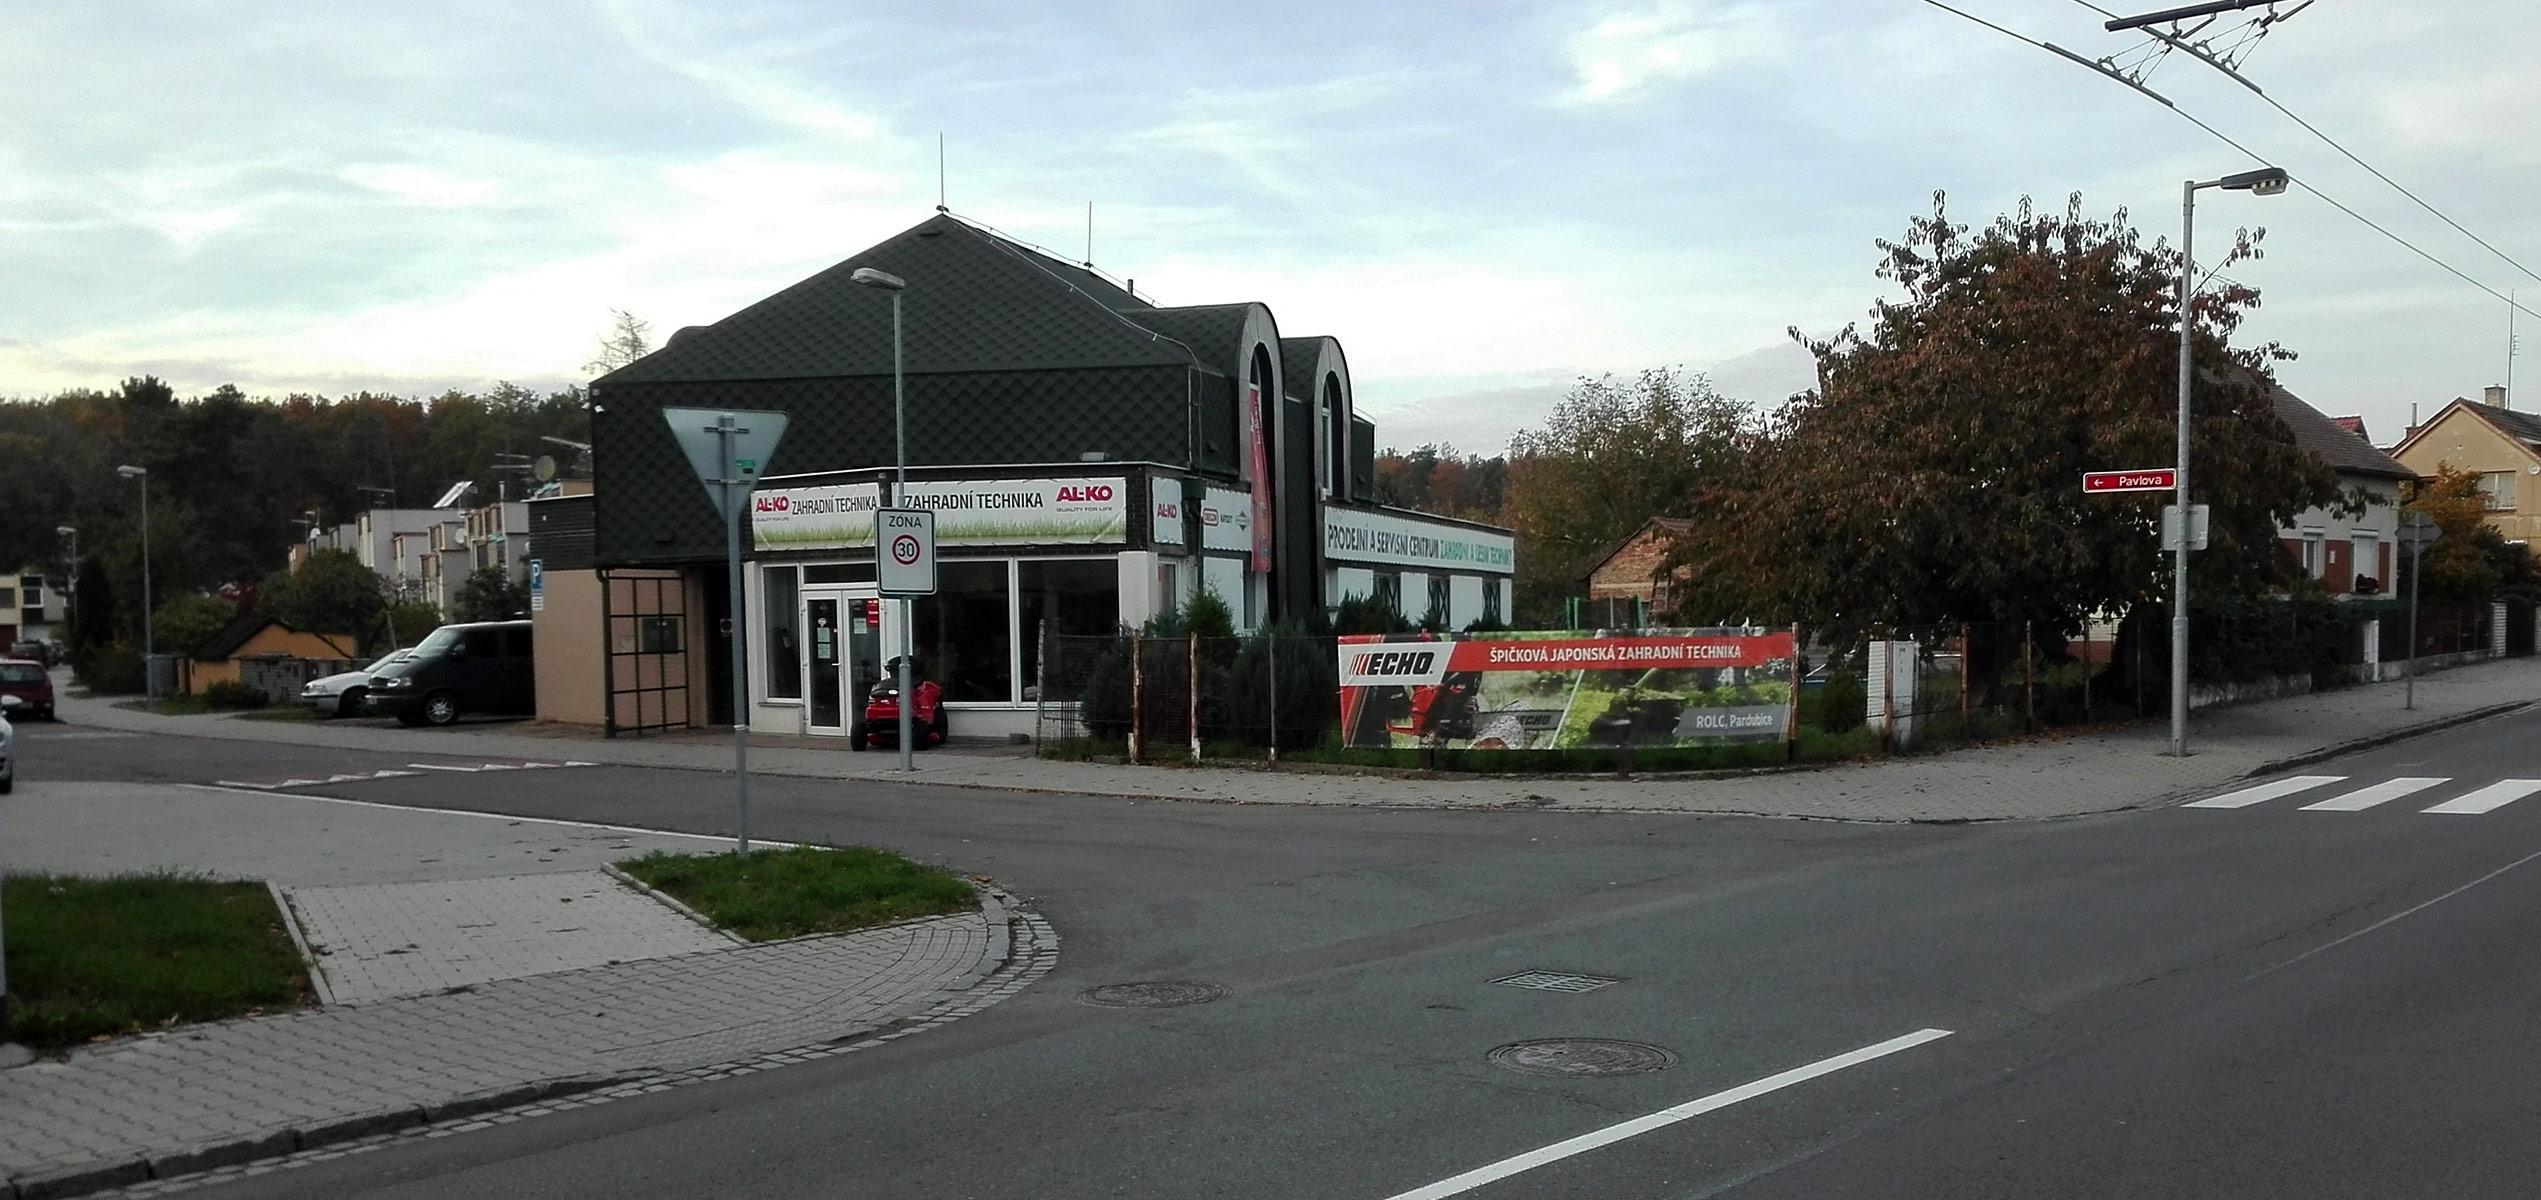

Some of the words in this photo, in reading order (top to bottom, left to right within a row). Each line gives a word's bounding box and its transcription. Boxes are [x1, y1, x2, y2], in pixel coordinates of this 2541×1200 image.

[2119, 476, 2162, 487] Pavlova
[904, 490, 974, 510] ZAHRADNÍ
[976, 492, 1043, 509] TECHNIKA
[1056, 485, 1113, 502] AL-KO
[756, 496, 789, 513] AL-KO
[792, 494, 834, 515] ZAHRADNÍ
[835, 495, 877, 513] TECHNIKA
[898, 543, 915, 558] 30
[1328, 523, 1368, 550] PRODEJNÍ
[1409, 535, 1439, 559] CENTRUM
[532, 564, 540, 584] P
[1489, 647, 1548, 663] ŠPIČKOVÁ
[1550, 645, 1615, 662] JAPONSKÁ
[1617, 643, 1683, 660] ZAHRADNÍ
[1686, 645, 1742, 659] TECHNIKA
[1366, 652, 1435, 676] ECHO
[1696, 714, 1729, 729] ROLC,
[1729, 712, 1773, 728] Pardubice
